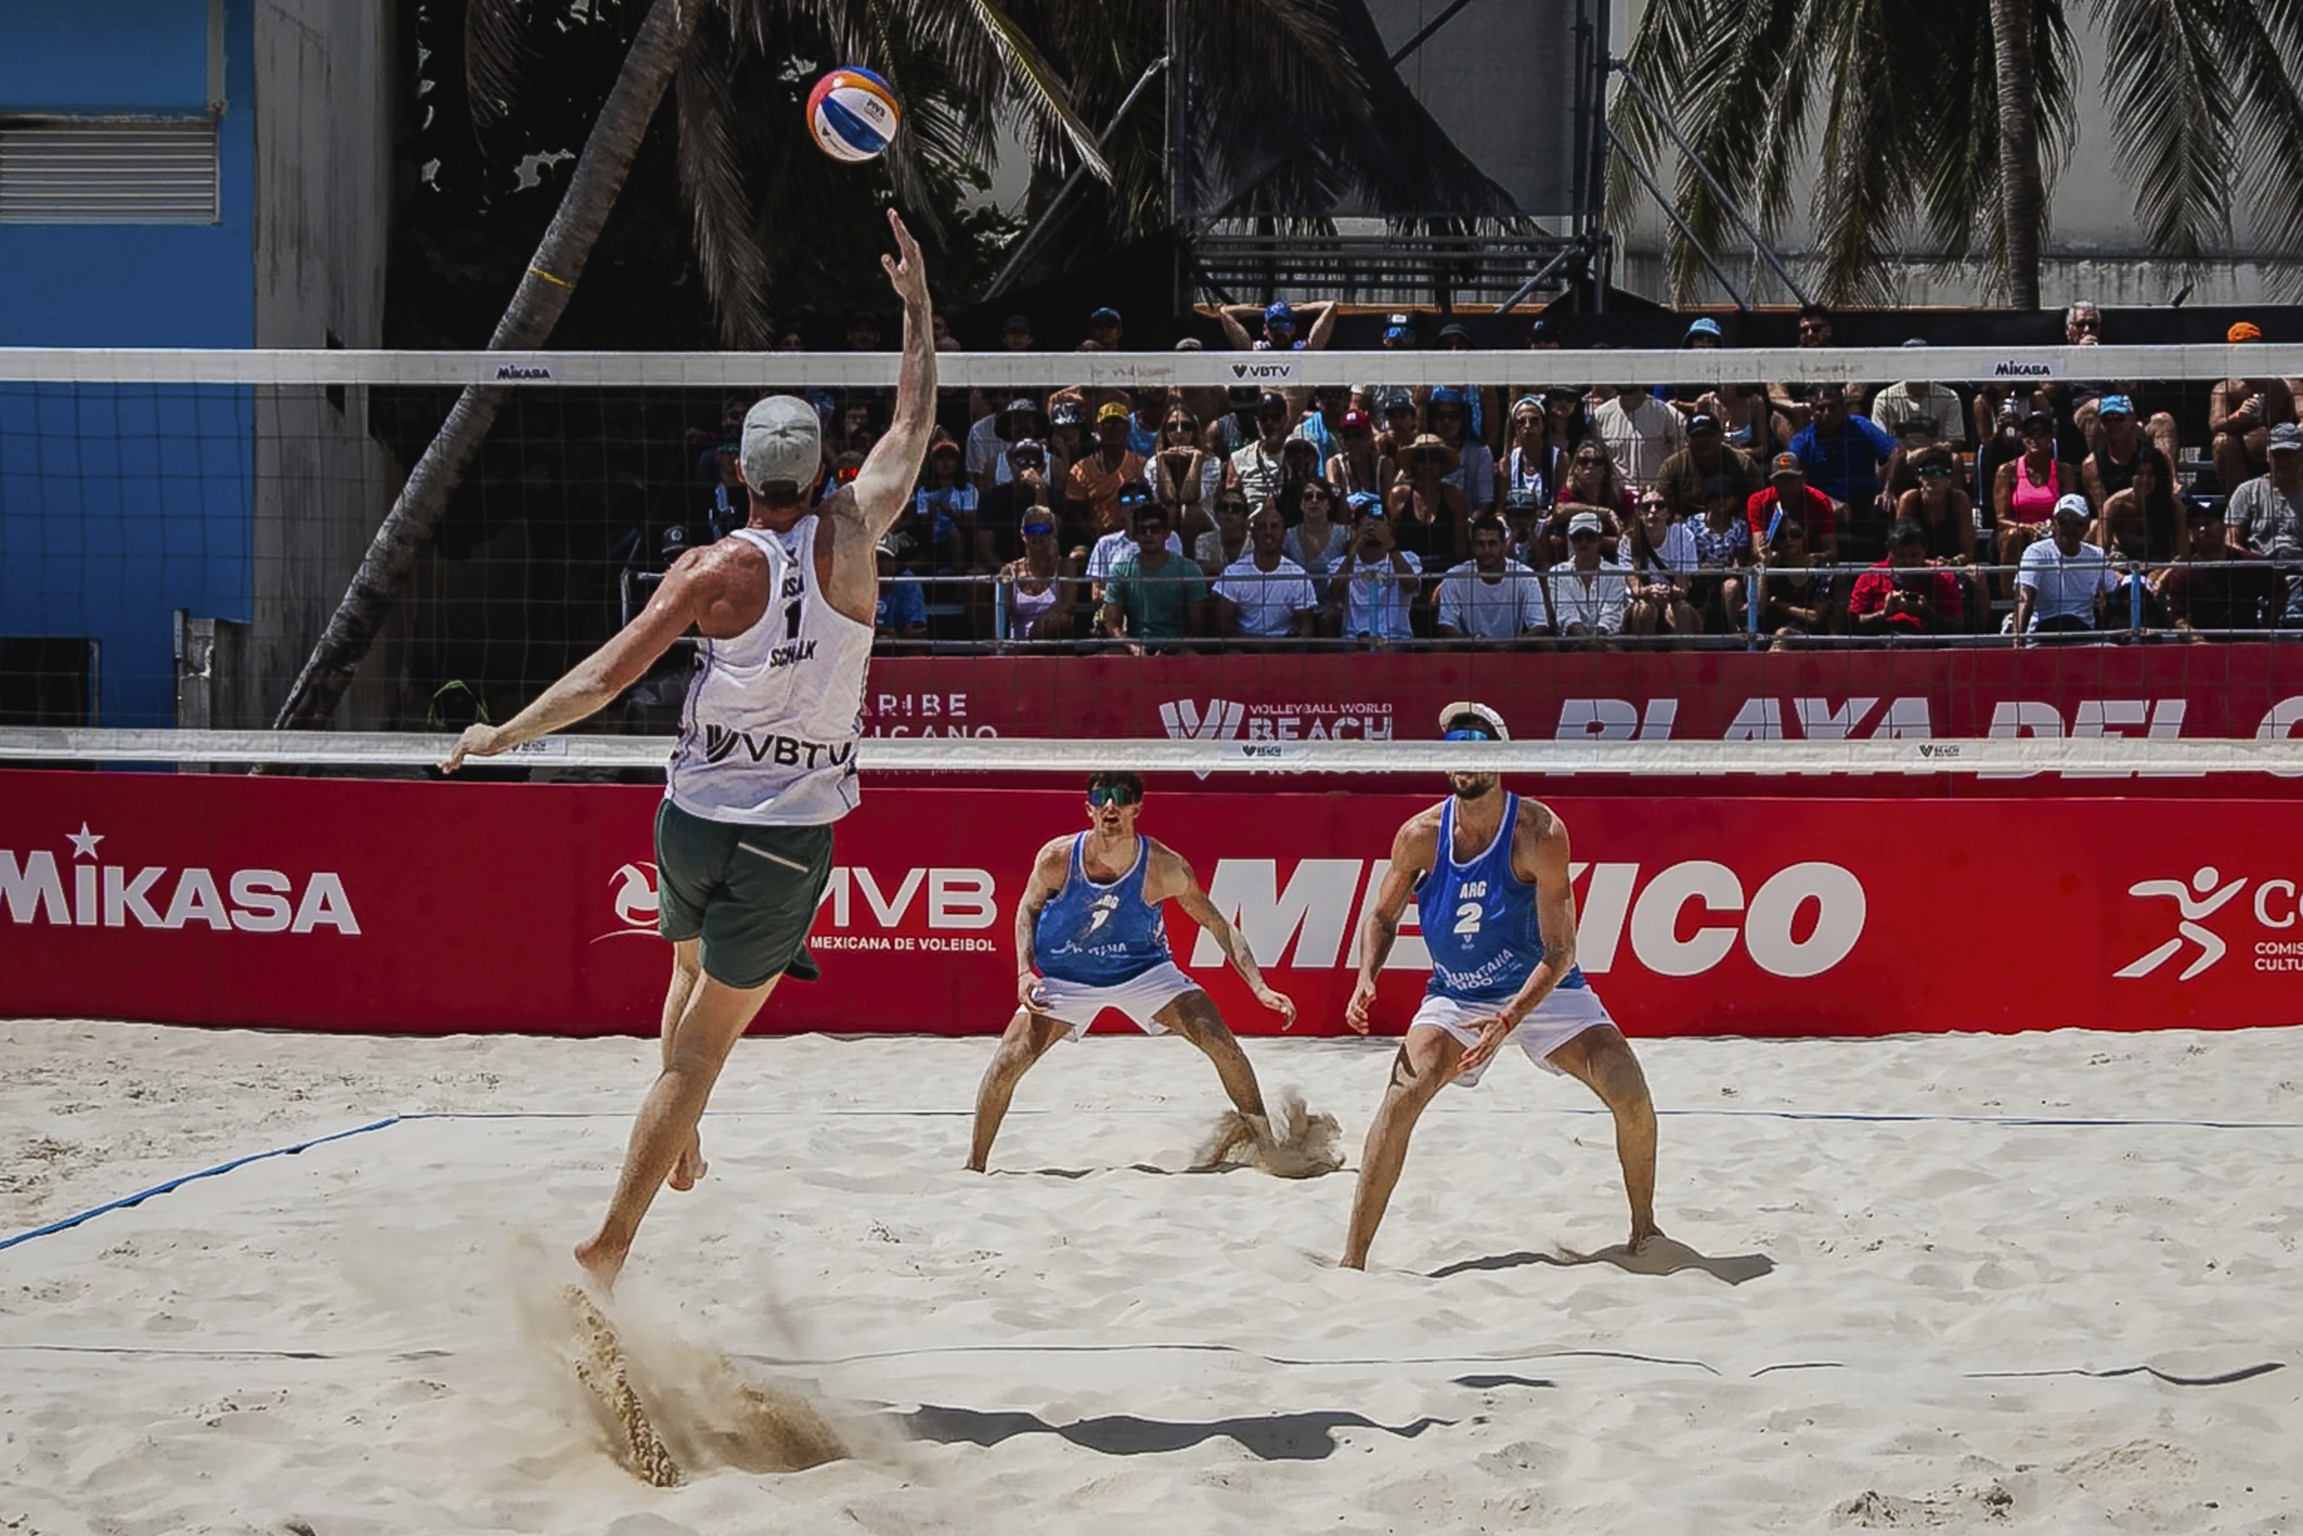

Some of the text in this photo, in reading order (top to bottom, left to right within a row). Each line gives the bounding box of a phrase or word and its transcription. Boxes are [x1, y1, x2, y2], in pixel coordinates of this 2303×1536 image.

[1250, 365, 1290, 378] VBTV
[784, 598, 802, 640] 1
[860, 694, 968, 717] RIBE
[1249, 703, 1393, 715] VOLLEYBALL WORLD
[1459, 881, 1487, 899] ARG
[2254, 879, 2303, 928] C
[1190, 858, 1867, 978] MICO
[1453, 902, 1483, 934] 2
[811, 936, 996, 951] MEXICANA DE VOLEIBOL
